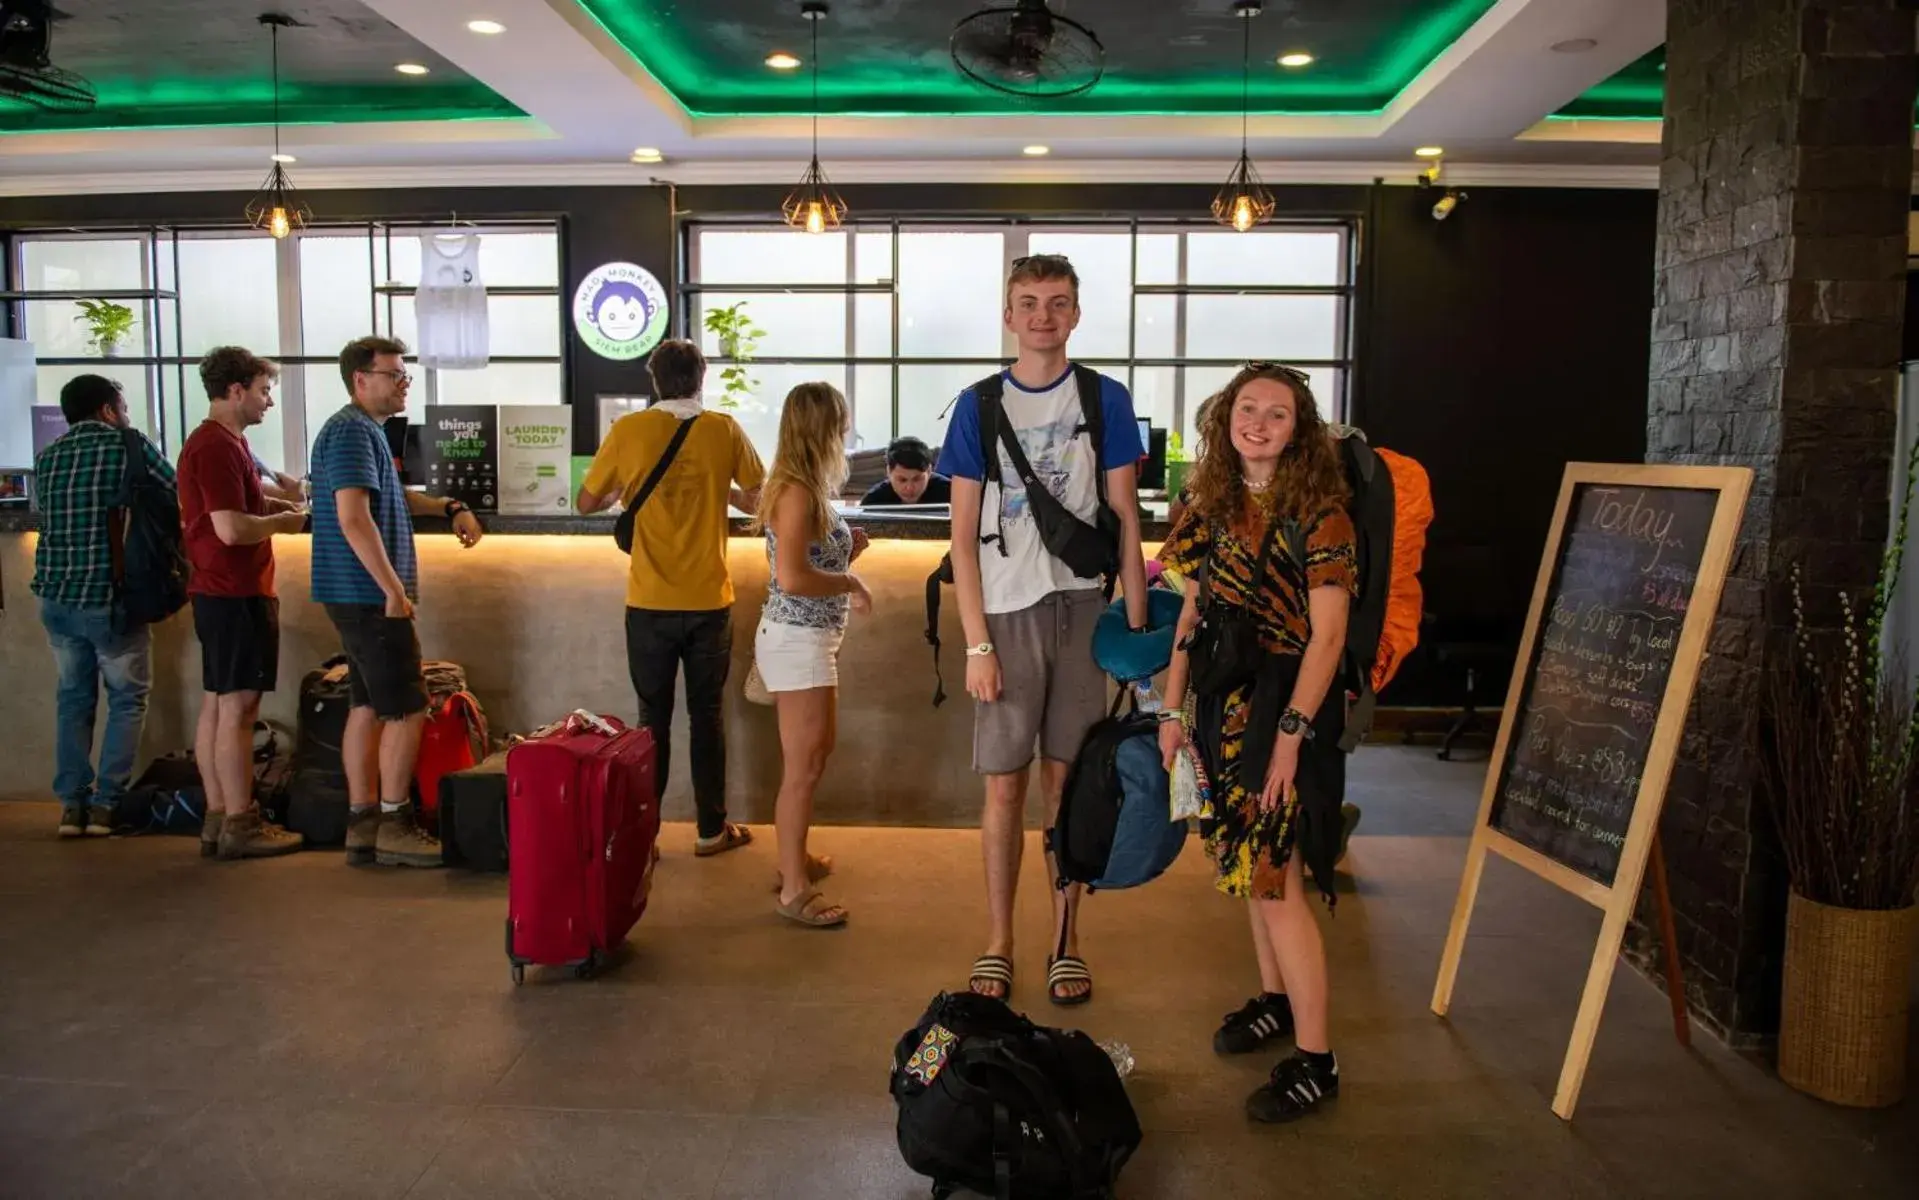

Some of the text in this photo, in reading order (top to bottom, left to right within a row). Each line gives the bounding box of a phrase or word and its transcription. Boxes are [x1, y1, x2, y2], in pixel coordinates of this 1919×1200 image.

[582, 268, 657, 302] MAD MONKEY
[595, 338, 621, 354] SIEM
[438, 418, 482, 432] things
[505, 425, 568, 436] LAUNDRY
[453, 430, 479, 441] you
[515, 435, 558, 444] TODAY
[435, 439, 487, 448] need to
[442, 447, 481, 458] know
